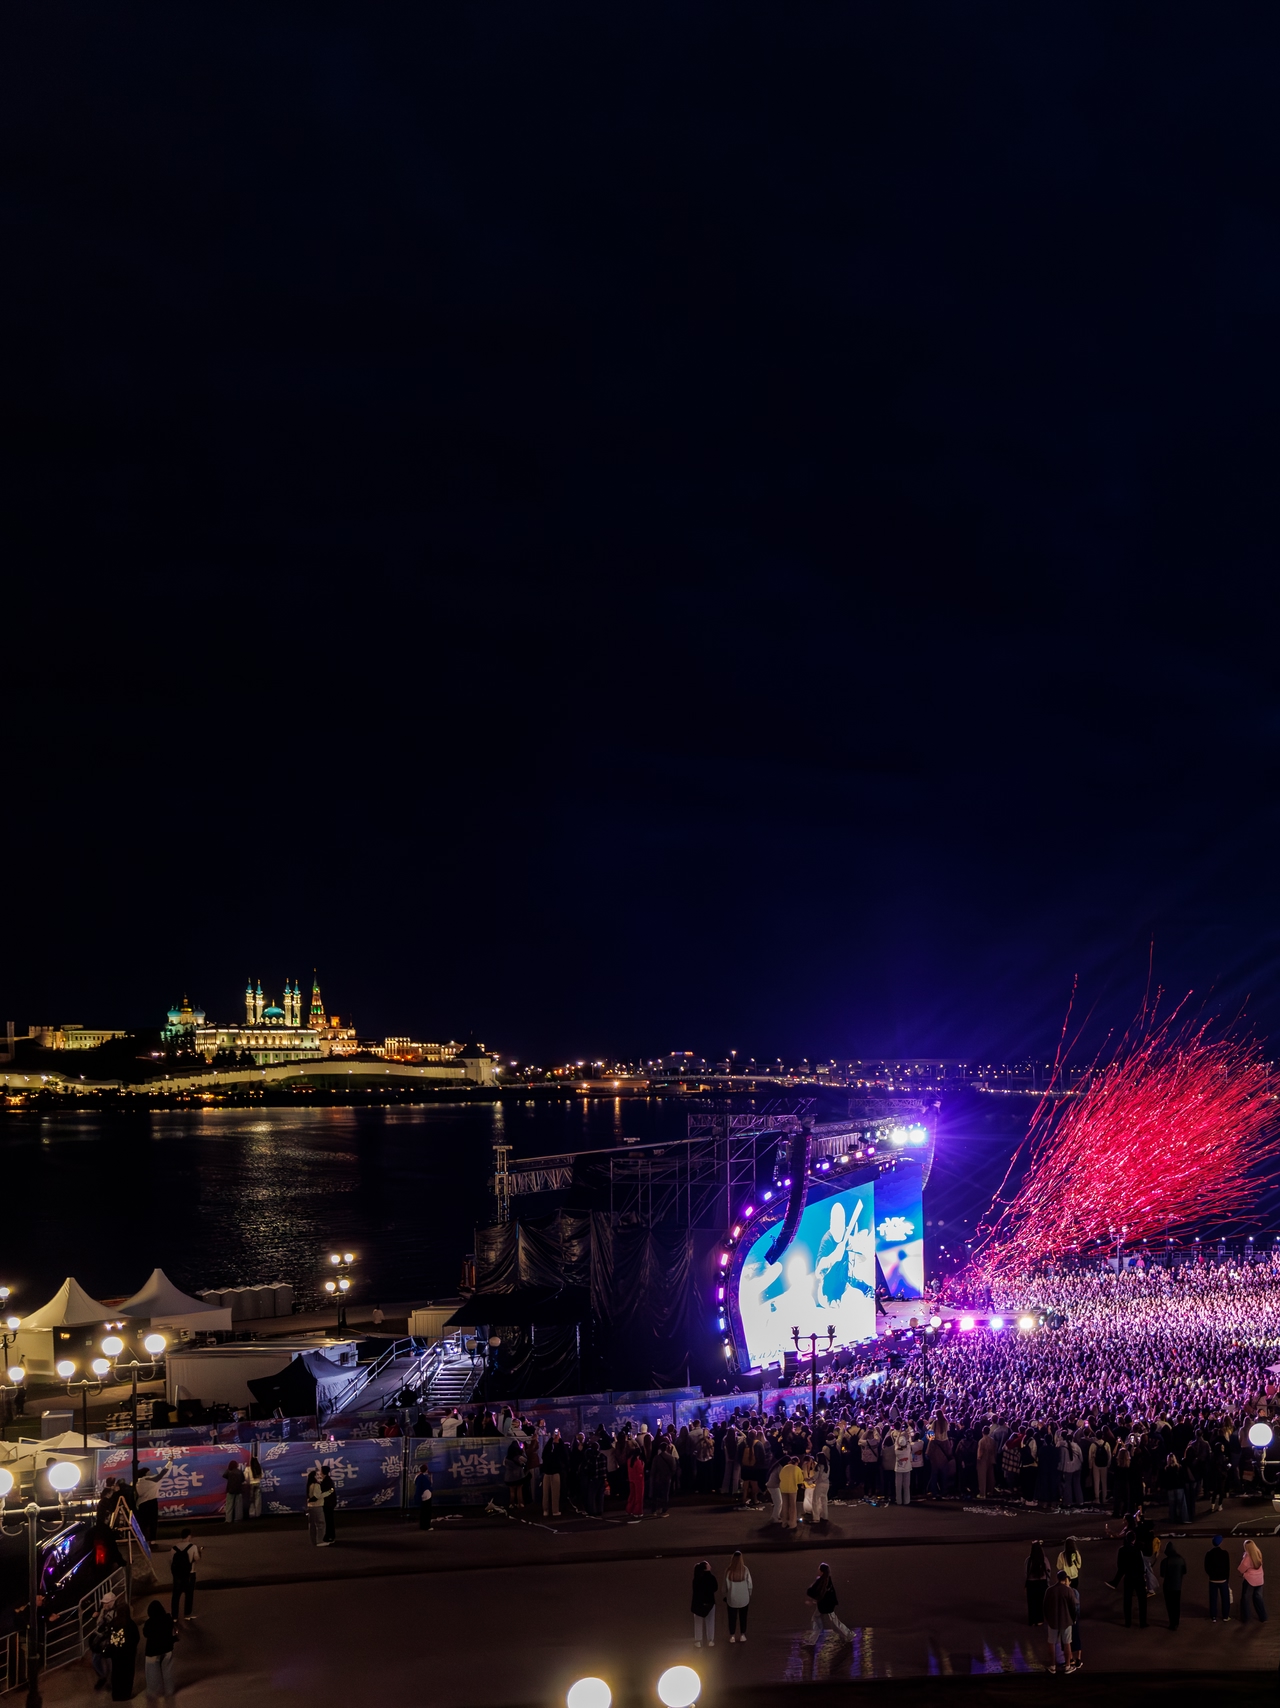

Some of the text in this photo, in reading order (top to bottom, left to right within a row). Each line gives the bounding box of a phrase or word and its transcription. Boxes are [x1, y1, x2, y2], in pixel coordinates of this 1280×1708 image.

[350, 1428, 380, 1438] fes
[315, 1457, 346, 1471] VK
[459, 1453, 488, 1466] VK
[301, 1463, 359, 1481] fst
[448, 1460, 500, 1479] fest
[159, 1471, 204, 1491] est
